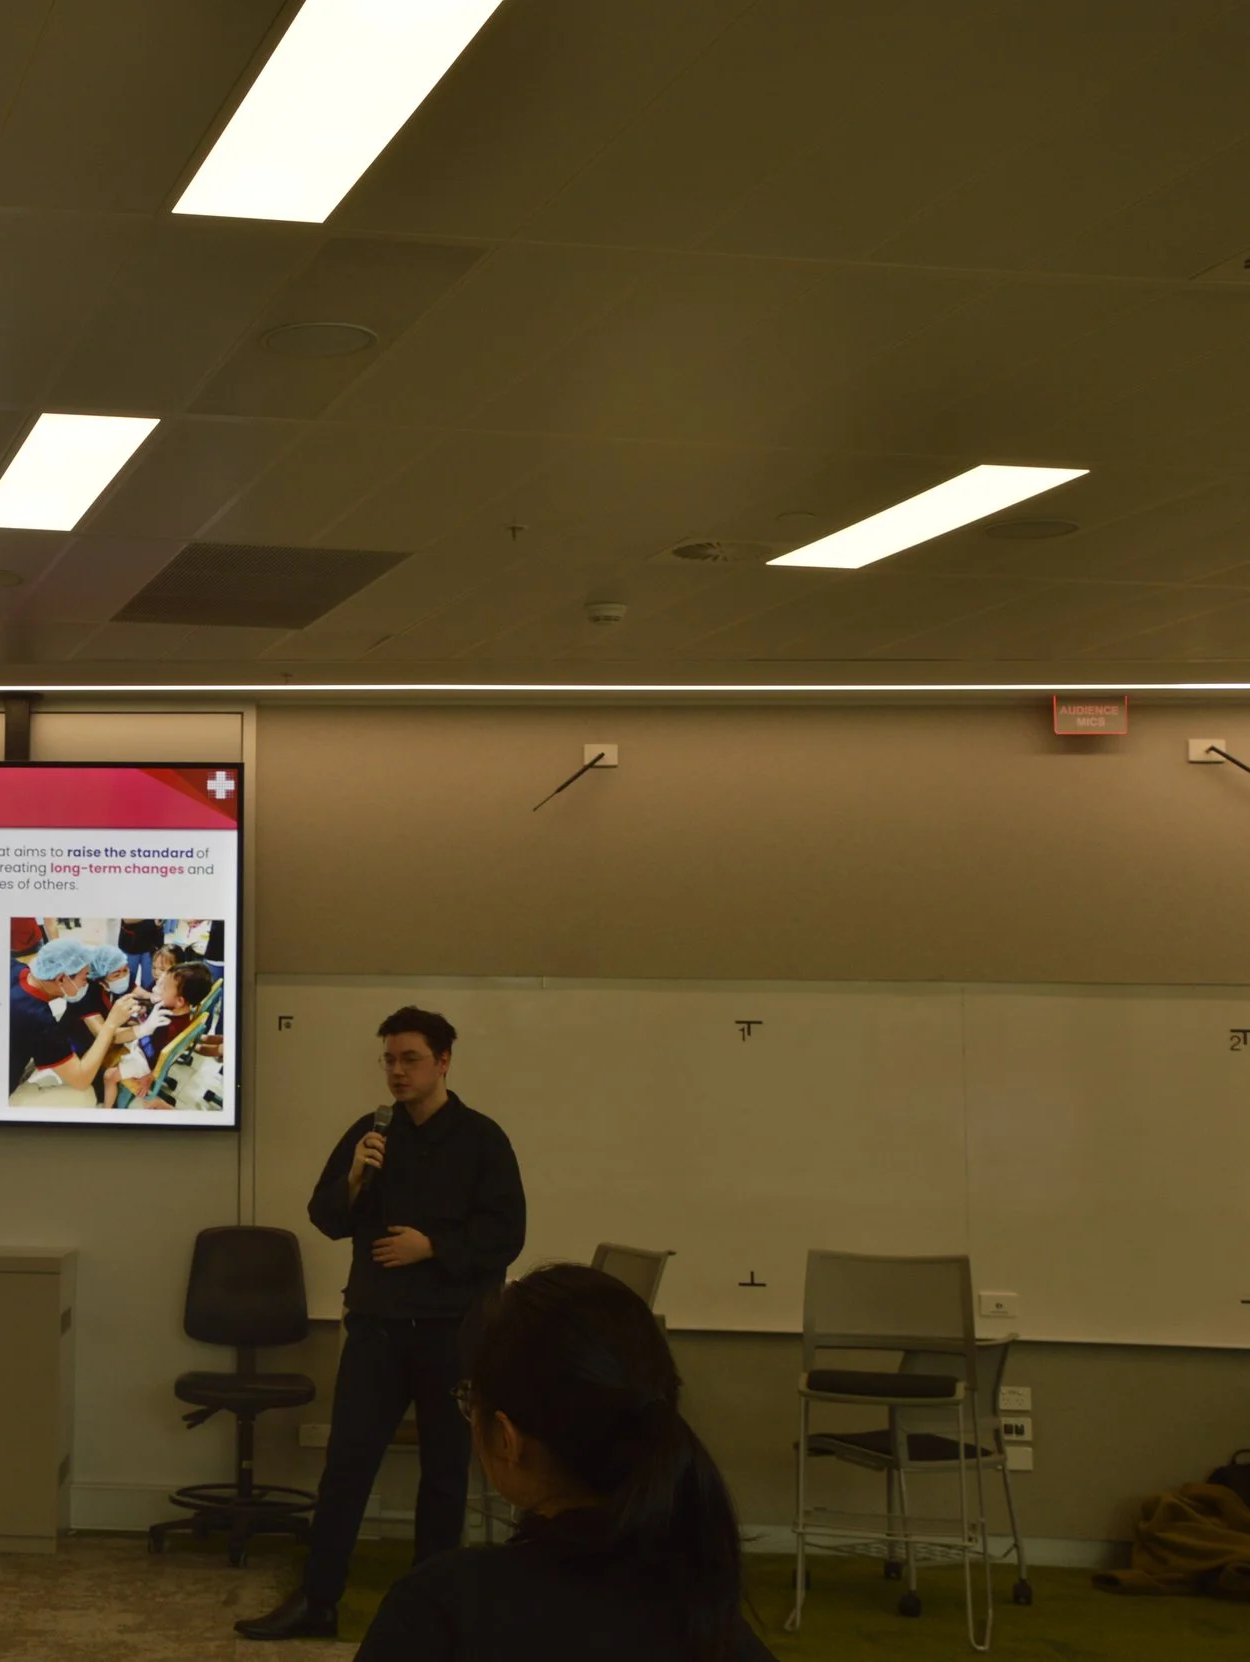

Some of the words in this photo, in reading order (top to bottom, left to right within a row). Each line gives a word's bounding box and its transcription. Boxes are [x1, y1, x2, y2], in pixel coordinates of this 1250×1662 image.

[1060, 705, 1119, 715] AUDIENCE
[1076, 717, 1105, 726] MICS
[14, 847, 46, 857] aims
[50, 848, 63, 857] to
[67, 847, 100, 858] raise
[105, 847, 126, 858] the
[130, 848, 193, 859] standard
[197, 848, 209, 859] of
[51, 863, 122, 877] long-term
[126, 864, 184, 877] changes
[188, 864, 214, 875] and
[17, 879, 30, 889] of
[34, 879, 78, 890] others.
[1230, 1035, 1241, 1051] 2
